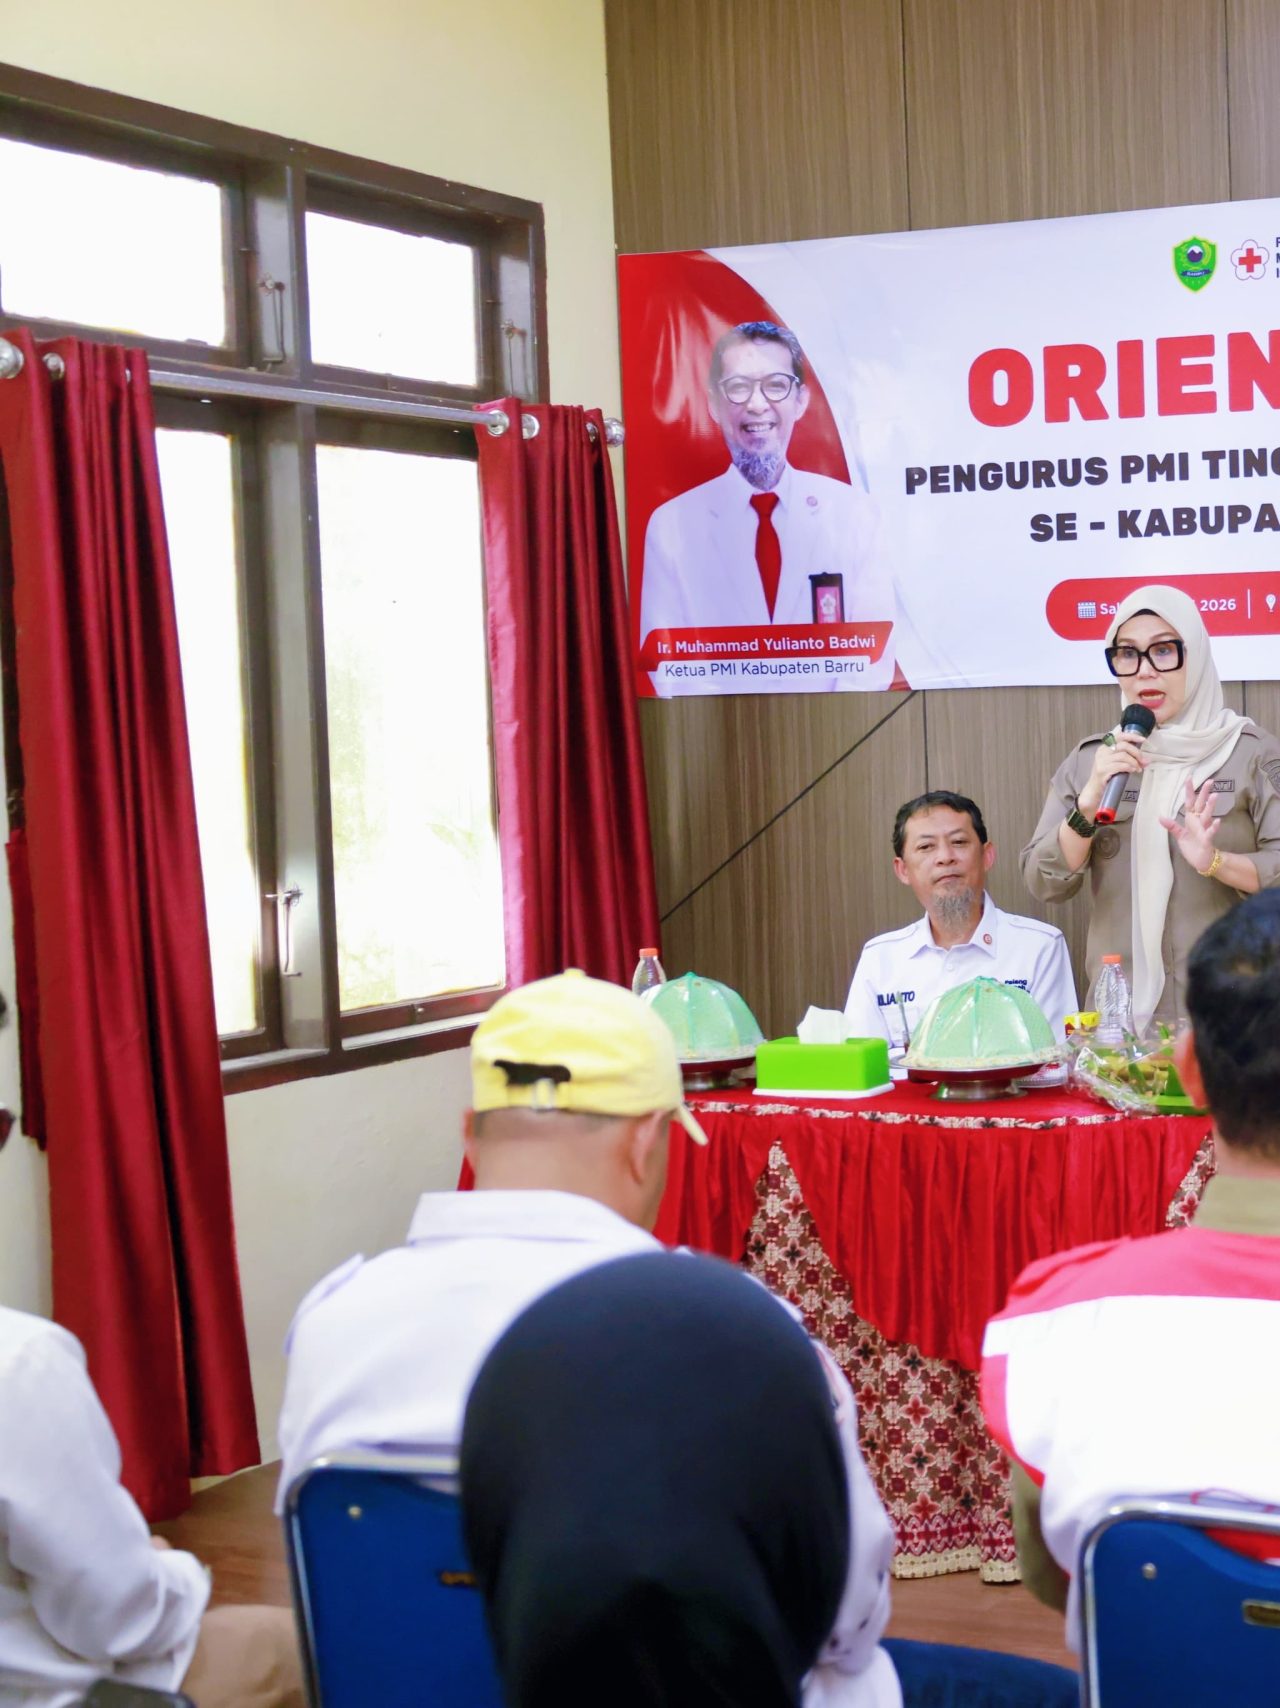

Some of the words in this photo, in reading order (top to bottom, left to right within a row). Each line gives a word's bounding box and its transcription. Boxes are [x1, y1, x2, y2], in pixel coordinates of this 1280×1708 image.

[905, 456, 1109, 495] PENGURUS
[1120, 452, 1189, 484] PMI
[1030, 512, 1078, 543] SE
[1200, 599, 1237, 612] 2026
[657, 641, 671, 654] Ir.
[676, 638, 759, 653] Muhammad
[763, 637, 825, 651] Yulianto
[829, 634, 876, 649] Badwi
[665, 664, 706, 677] Ketua
[710, 662, 737, 676] PMI
[741, 661, 820, 677] Kabupaten
[824, 659, 864, 673] Barru
